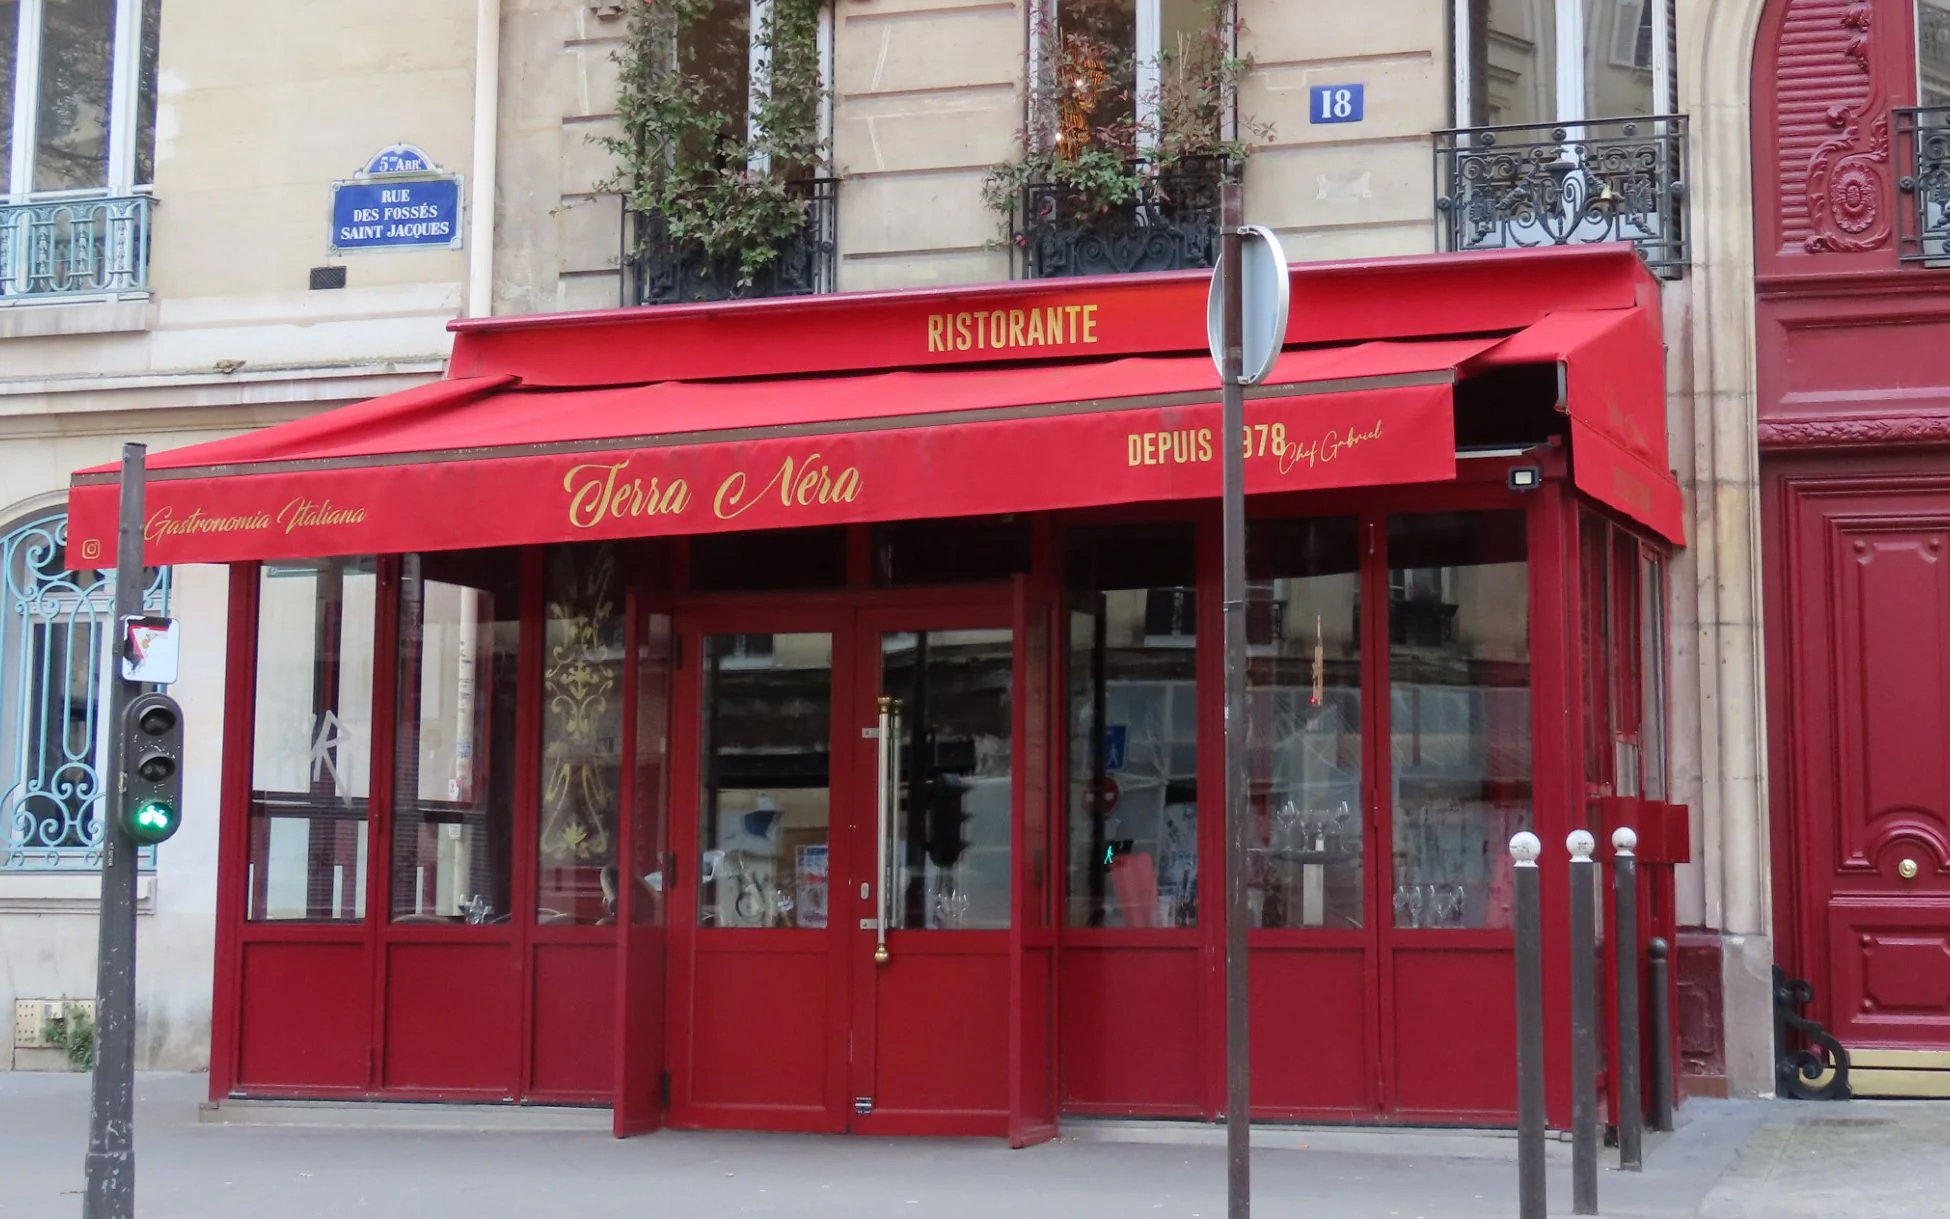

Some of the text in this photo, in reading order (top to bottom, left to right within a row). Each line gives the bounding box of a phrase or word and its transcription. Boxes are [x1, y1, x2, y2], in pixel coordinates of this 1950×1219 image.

[1321, 89, 1352, 119] 18
[353, 202, 438, 222] DES FOSSÉS
[381, 189, 410, 203] RUE
[340, 221, 450, 240] SAINT JACQUES
[928, 304, 1098, 352] RISTORANTE
[1128, 422, 1286, 467] DEPUIS 978
[1278, 419, 1384, 474] Chef Gabriel
[563, 453, 864, 528] Terra Nera
[144, 496, 368, 546] Gastronomia Italiana
